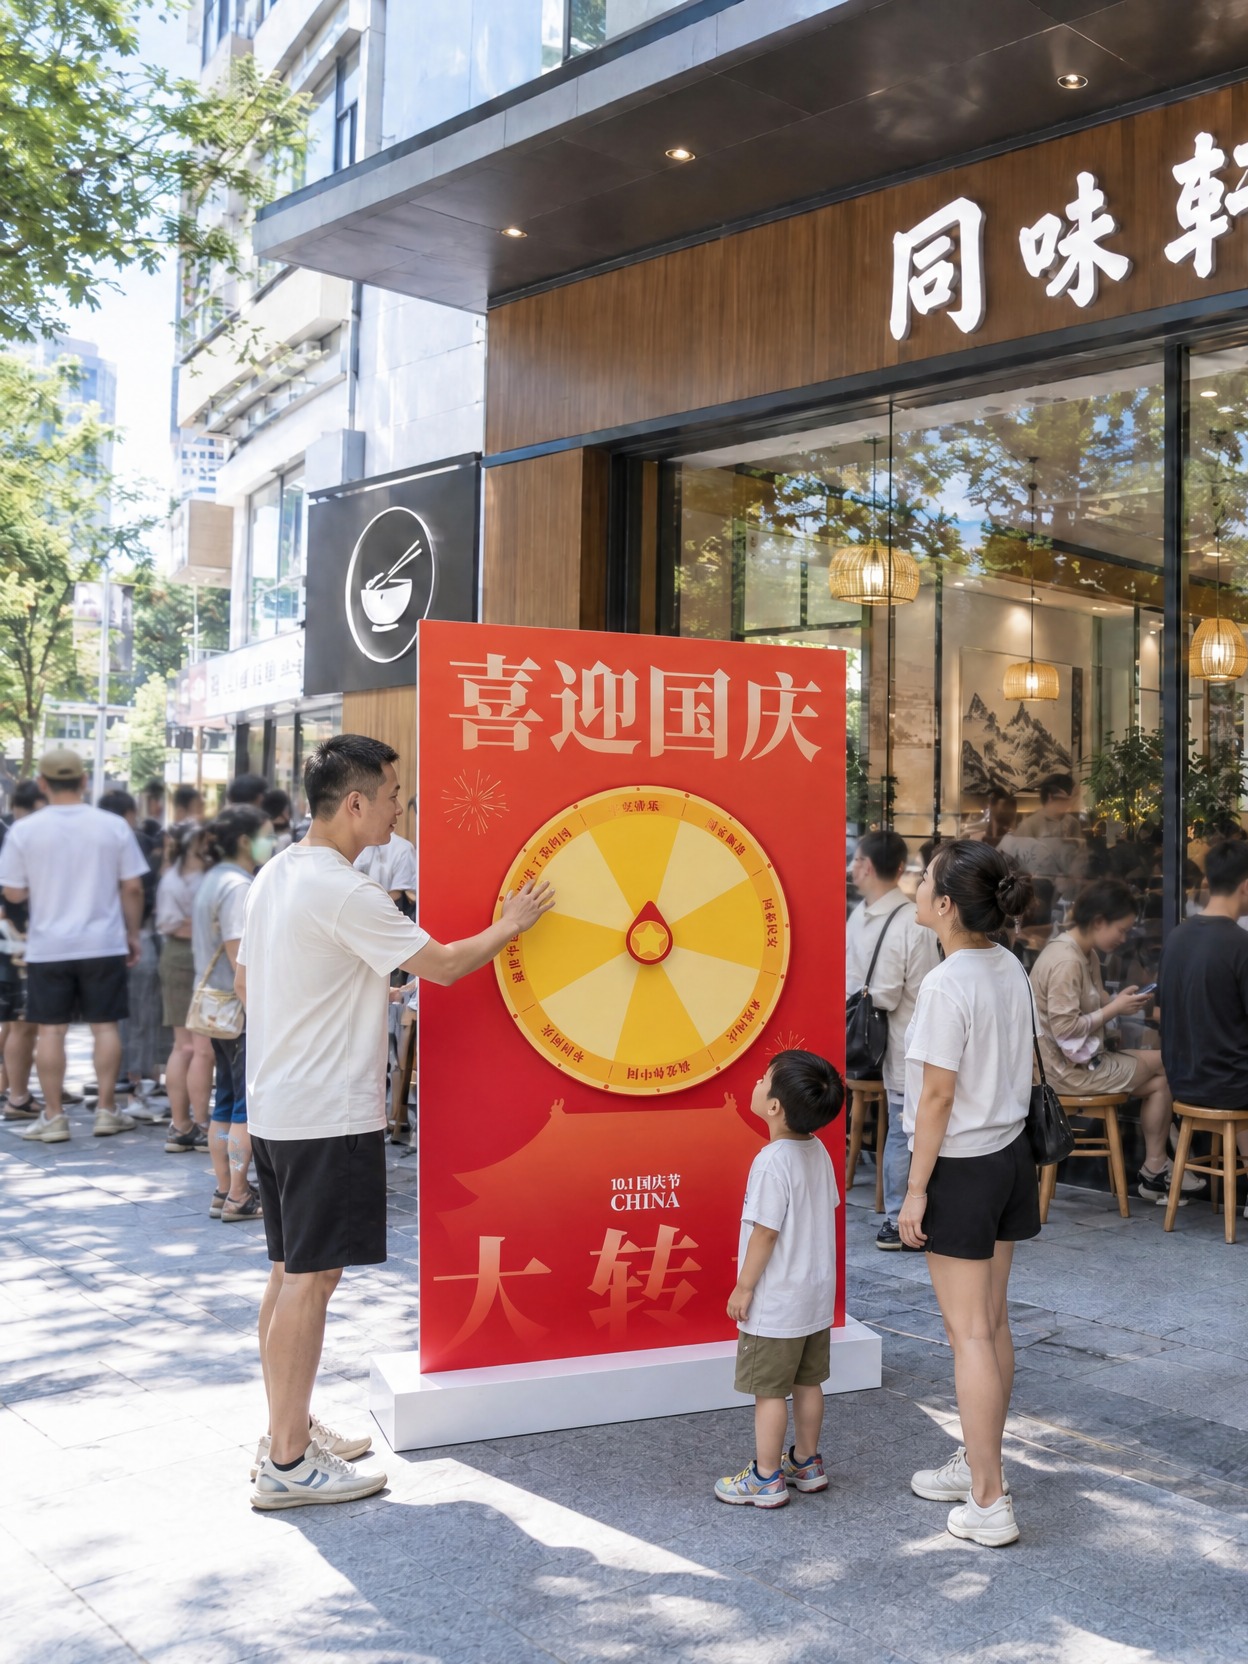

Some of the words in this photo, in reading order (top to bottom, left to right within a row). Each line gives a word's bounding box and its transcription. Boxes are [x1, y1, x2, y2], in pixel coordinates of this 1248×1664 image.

[448, 652, 823, 764] 喜迎国庆
[610, 1191, 681, 1212] CHINA
[433, 1223, 738, 1353] 大转
